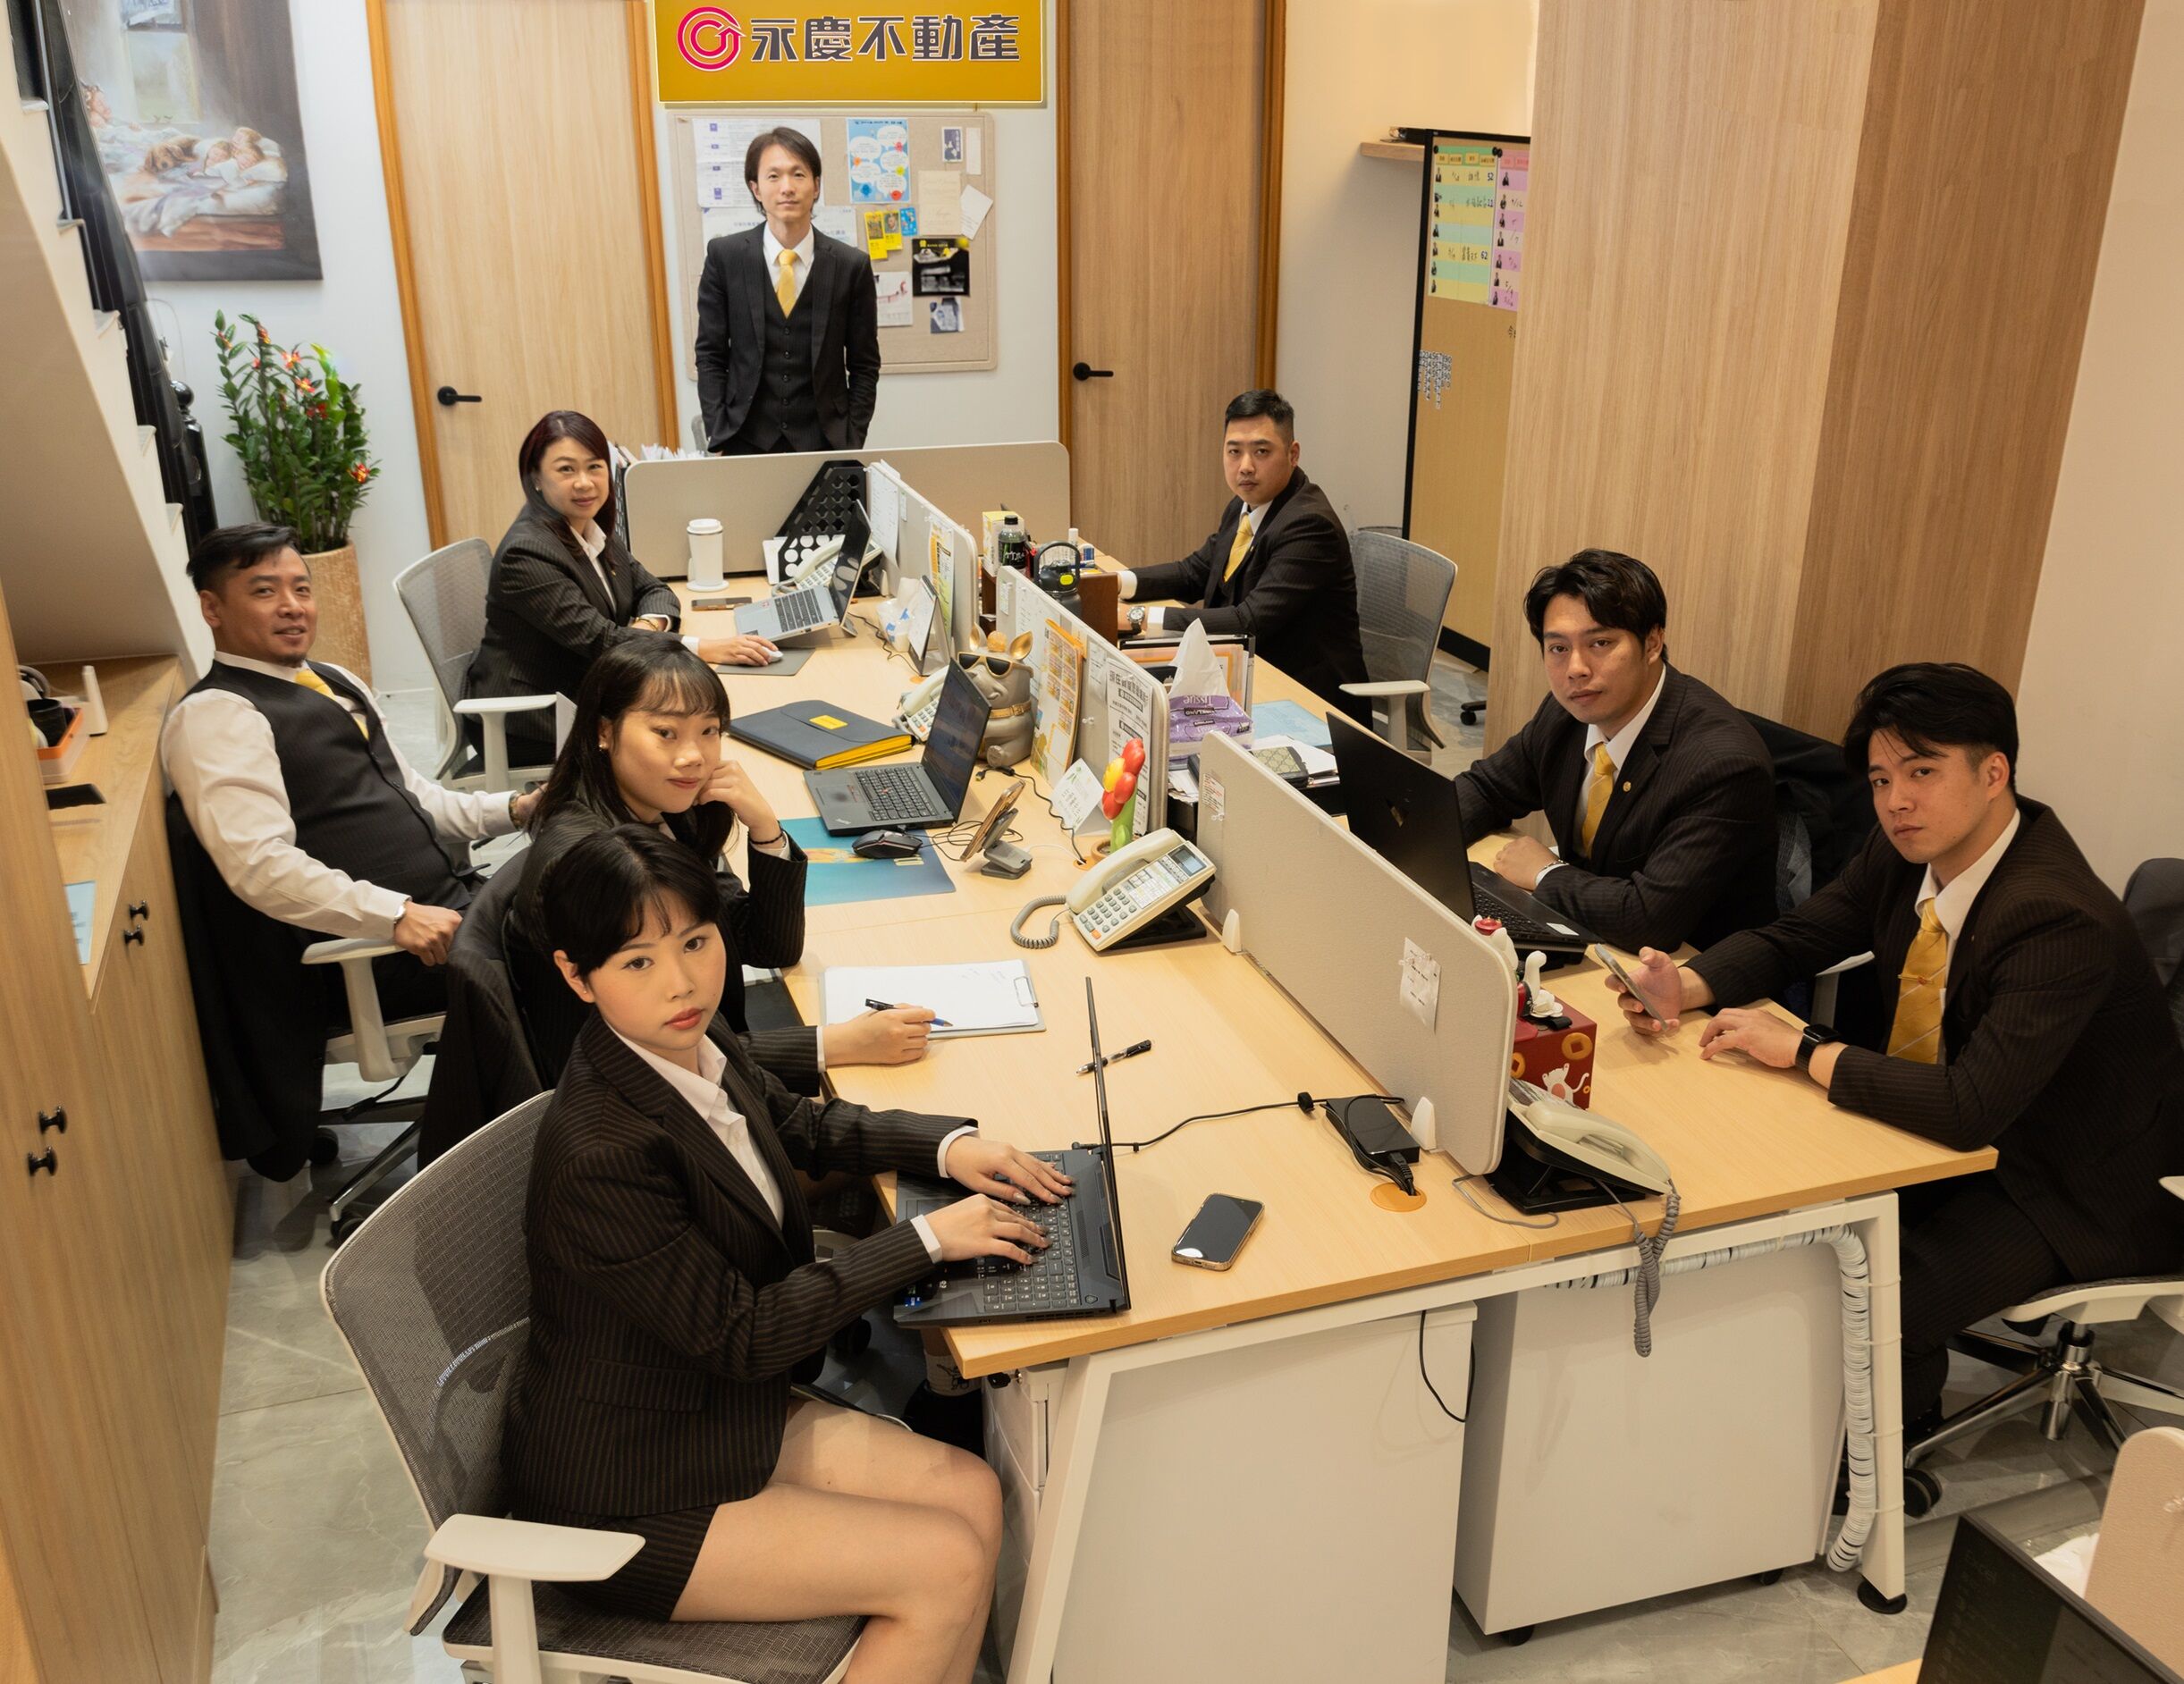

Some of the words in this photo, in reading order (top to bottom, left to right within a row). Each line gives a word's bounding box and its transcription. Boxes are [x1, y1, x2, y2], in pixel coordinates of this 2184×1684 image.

[750, 13, 1020, 62] 永慶不動產
[1183, 695, 1213, 707] Tissue
